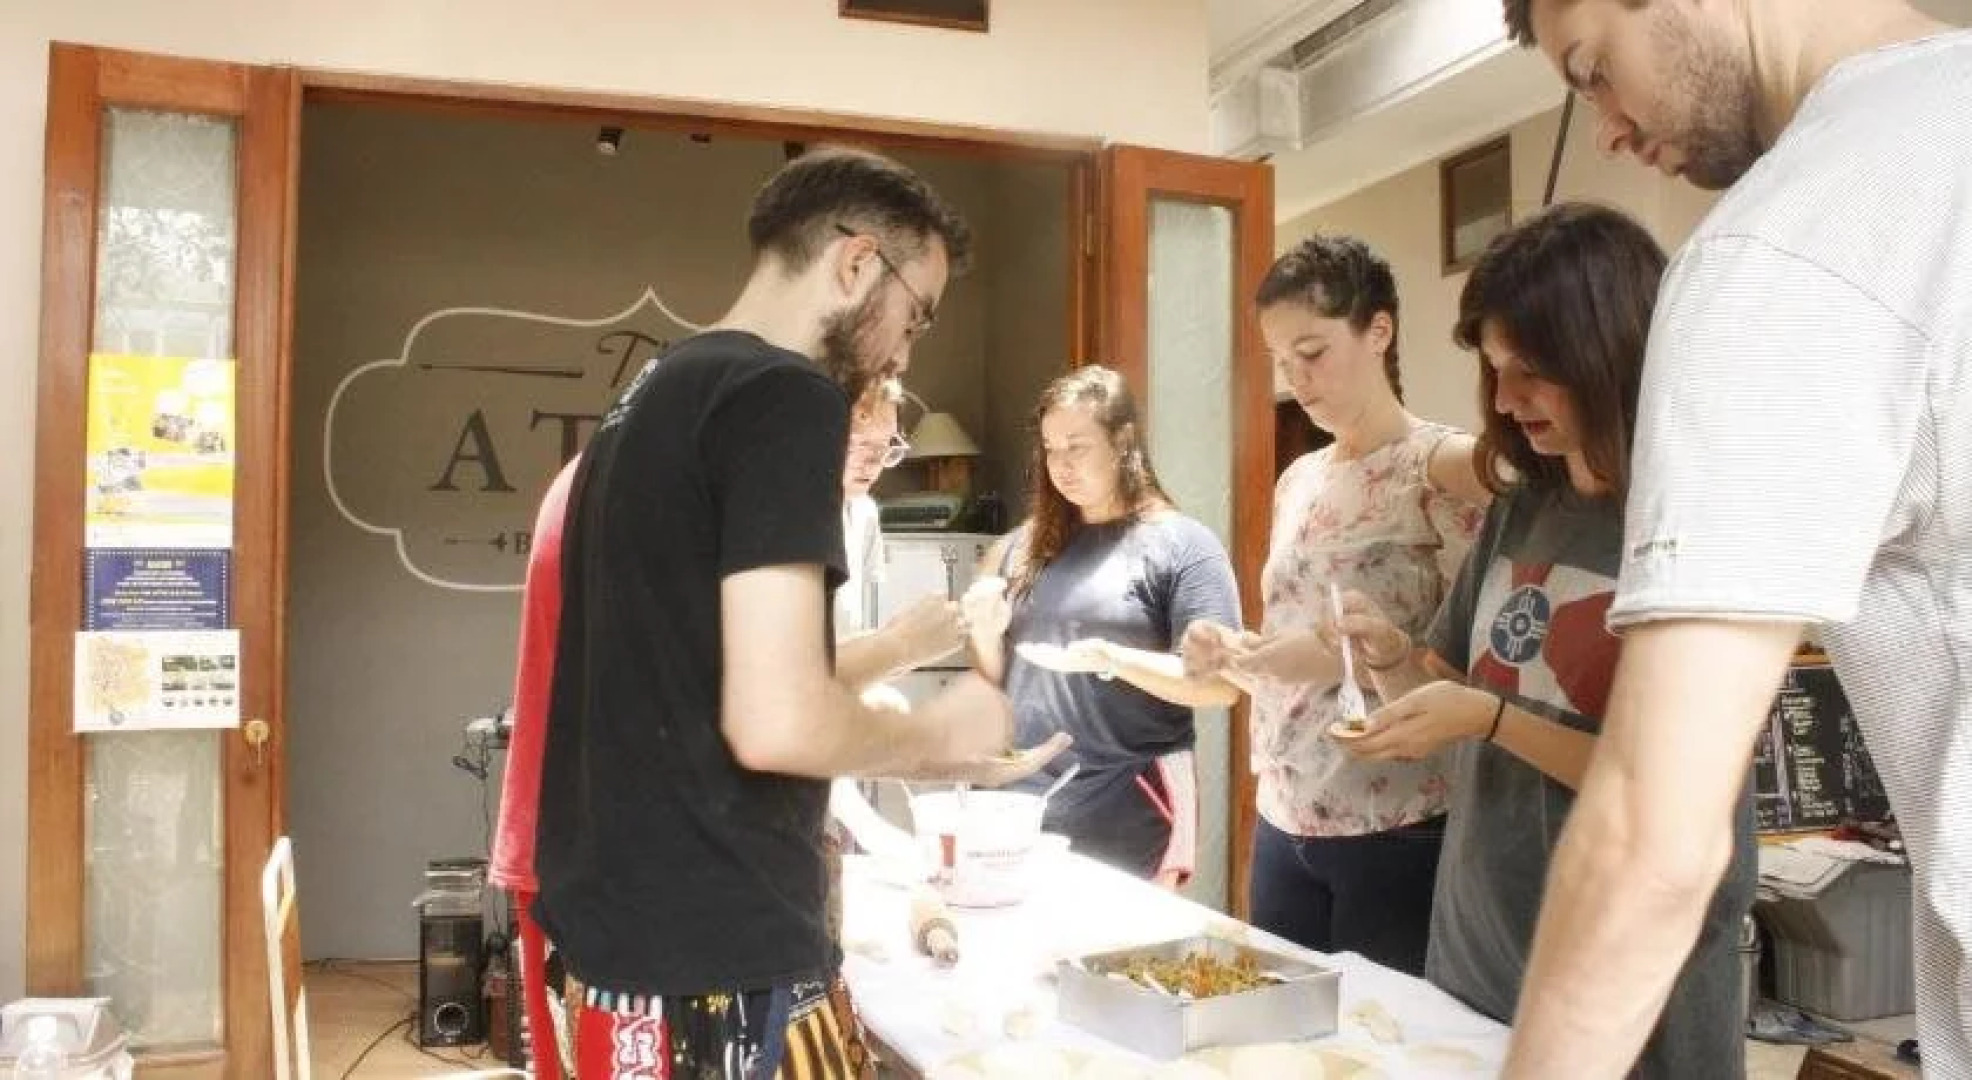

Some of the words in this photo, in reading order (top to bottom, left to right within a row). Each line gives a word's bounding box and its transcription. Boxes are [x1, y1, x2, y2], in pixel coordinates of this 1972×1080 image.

[596, 330, 669, 390] T
[428, 408, 603, 492] AT
[513, 530, 532, 555] B
